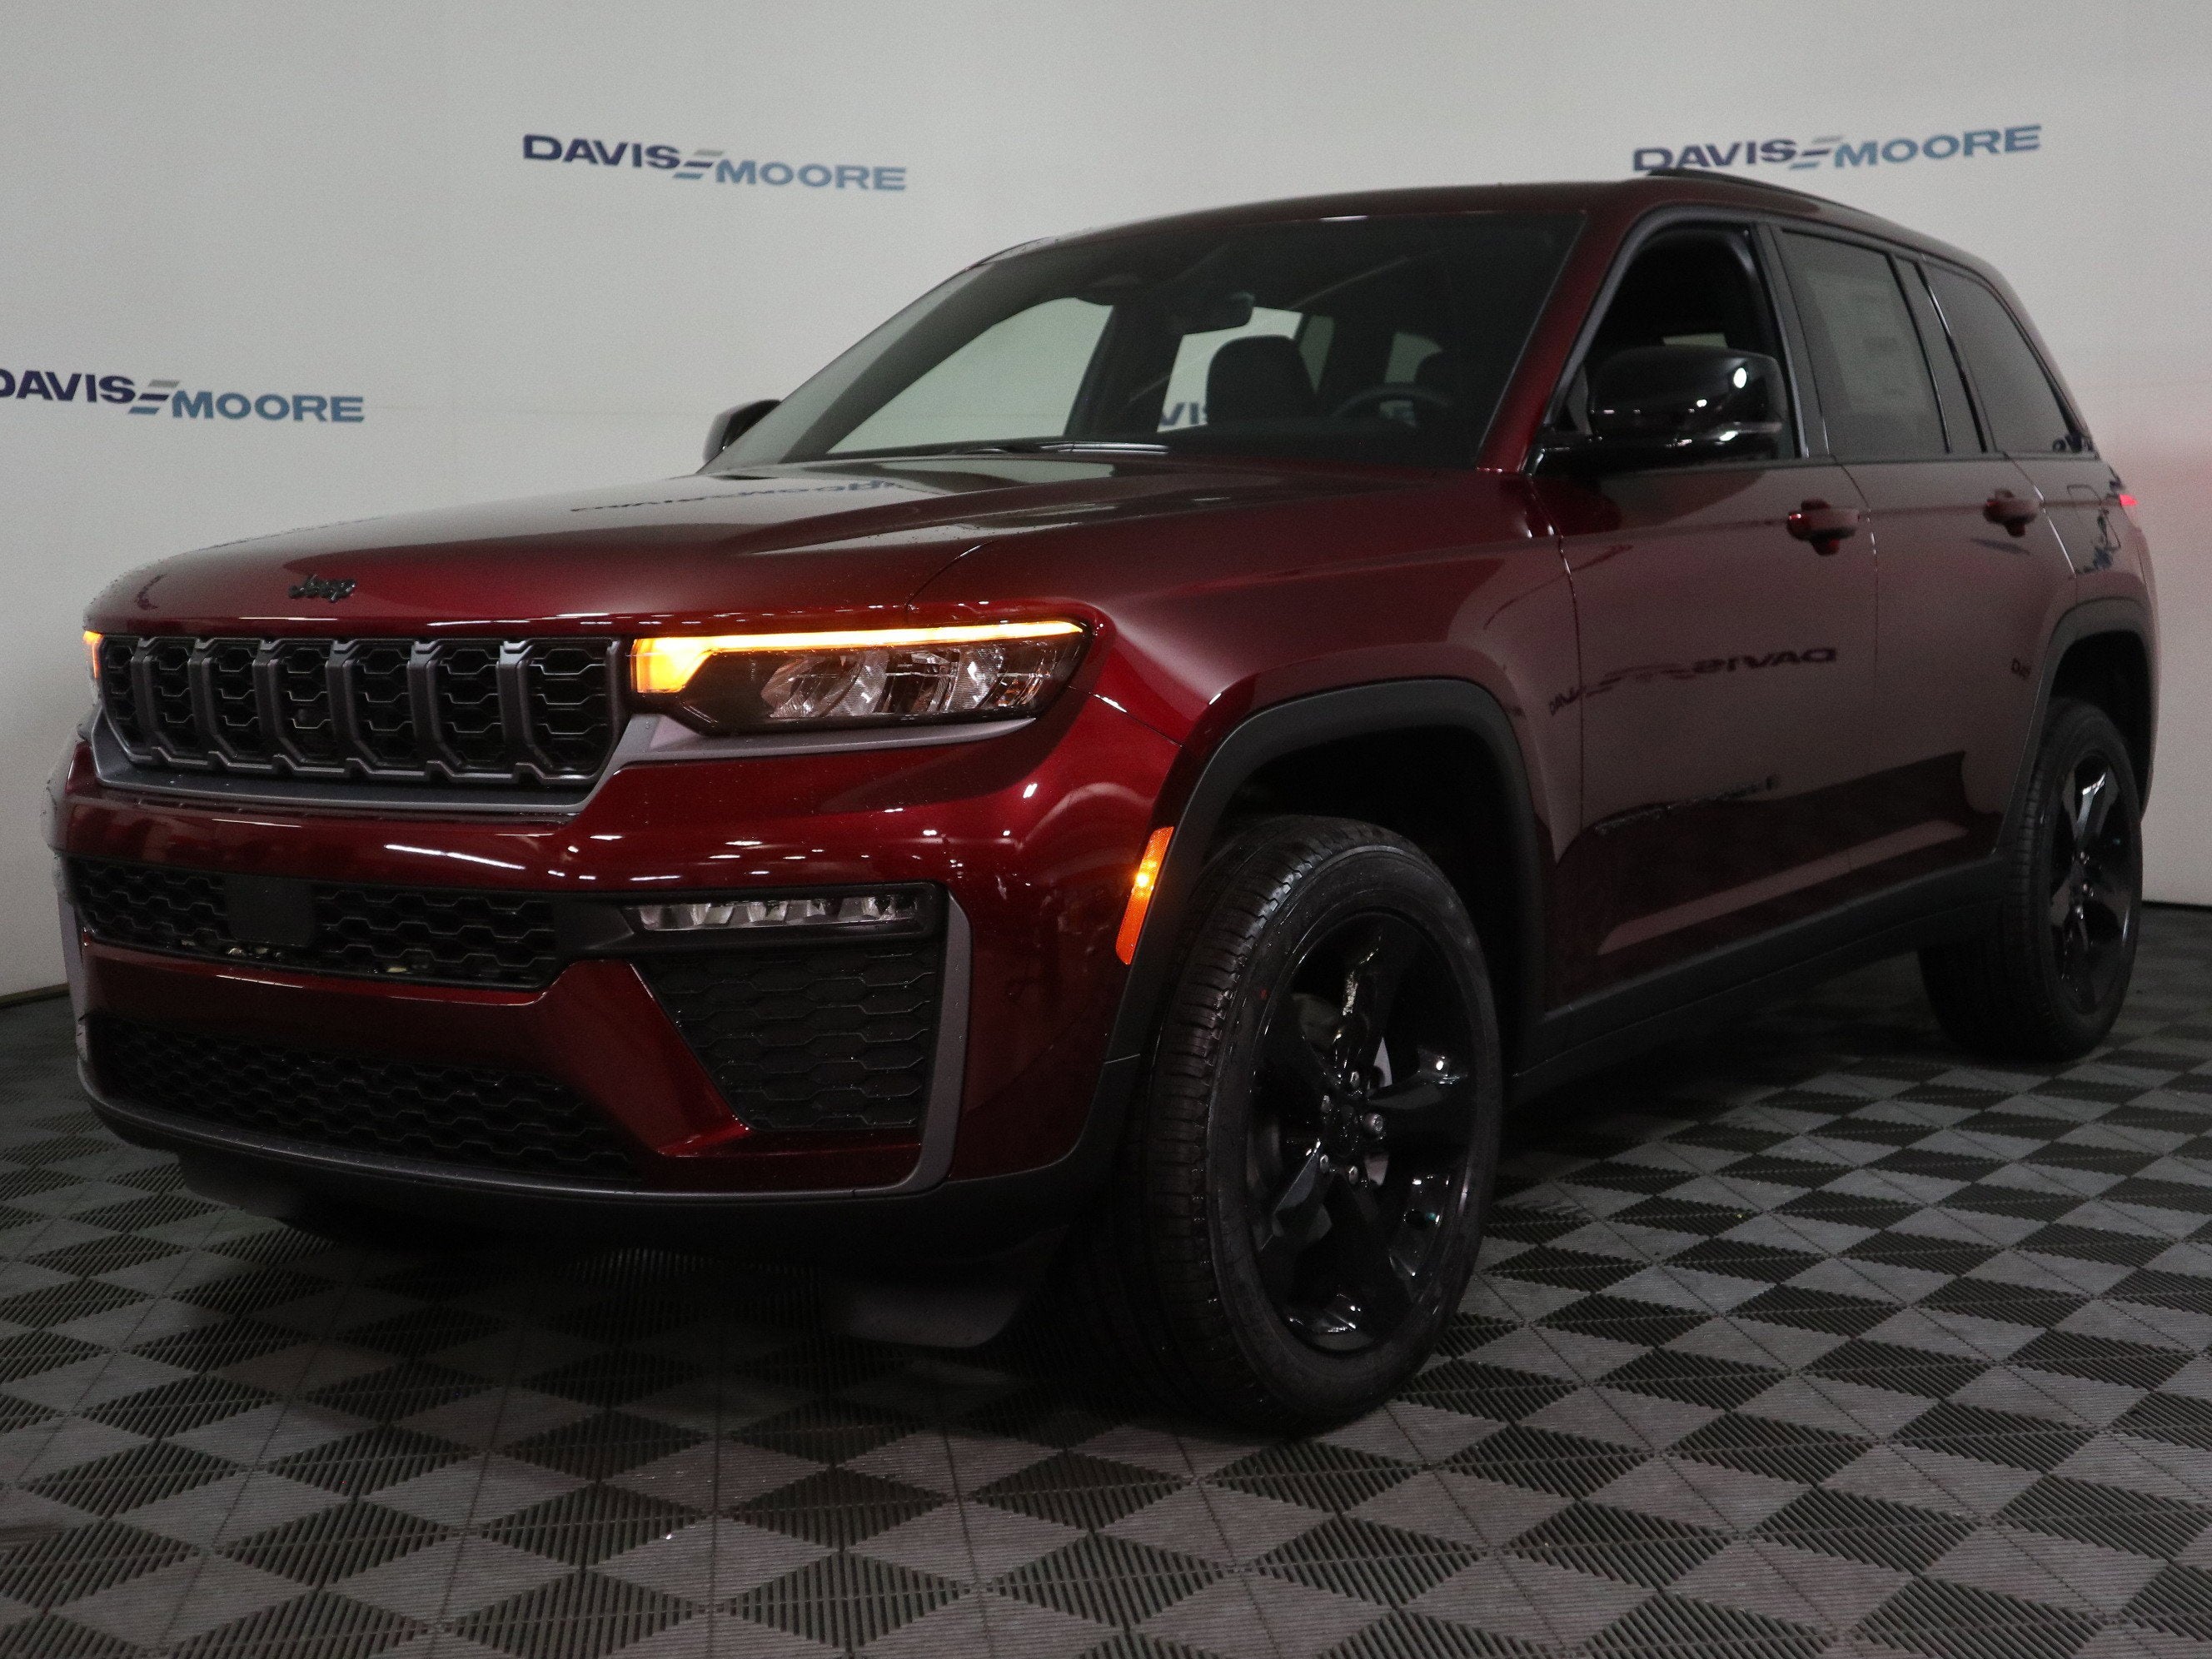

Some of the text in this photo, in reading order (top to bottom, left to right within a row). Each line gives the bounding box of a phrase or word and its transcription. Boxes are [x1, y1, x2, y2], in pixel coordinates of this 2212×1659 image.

[522, 134, 906, 192] DAVIS MOORE
[1633, 124, 2042, 171] DAVIS MOORE
[171, 390, 365, 422] MOORE
[288, 575, 356, 603] Jeep
